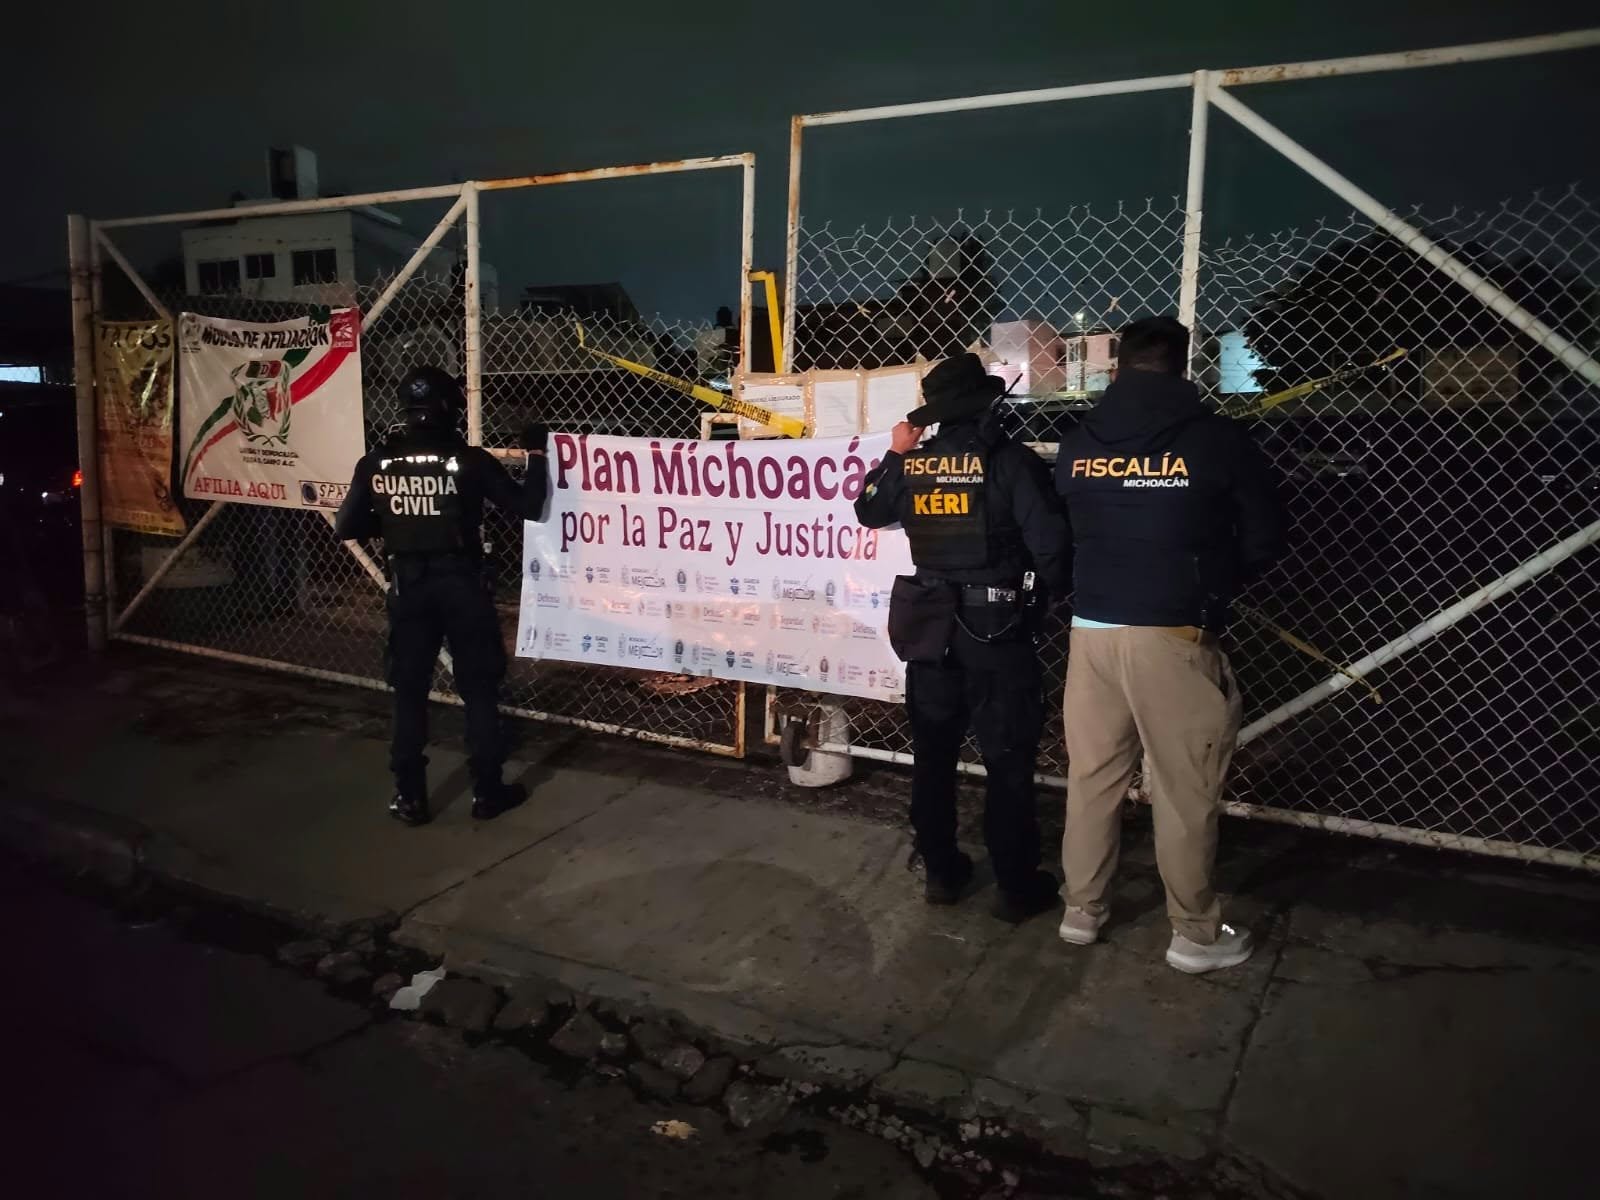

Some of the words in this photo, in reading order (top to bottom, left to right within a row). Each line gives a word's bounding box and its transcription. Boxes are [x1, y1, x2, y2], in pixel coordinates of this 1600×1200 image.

[243, 331, 260, 349] DE
[553, 434, 641, 494] Plan
[649, 435, 882, 501] Michoacá
[903, 452, 984, 476] FISCALÍA
[1071, 451, 1189, 479] FISCALÍA
[193, 477, 243, 497] AFILIA
[247, 481, 288, 501] AQUI
[371, 473, 458, 496] GUARDIA
[935, 474, 984, 486] MICHOACÁN
[1122, 477, 1189, 489] MICHOACÁN
[390, 495, 441, 516] CIVIL
[913, 488, 969, 515] KÉRI
[560, 508, 610, 553] por
[620, 503, 646, 547] la
[657, 505, 713, 552] Paz
[724, 520, 743, 566] y
[755, 510, 878, 561] Justicia
